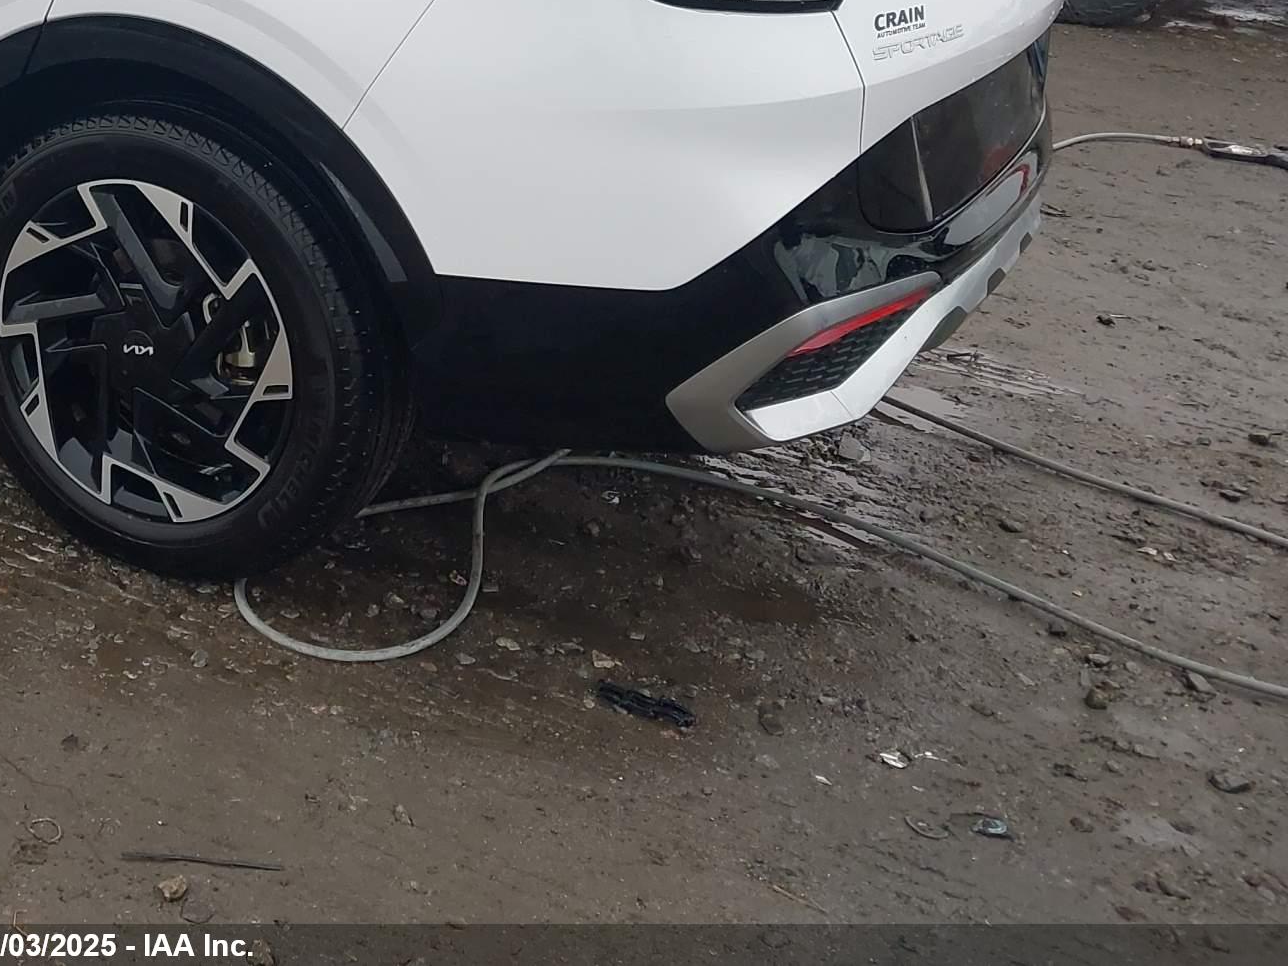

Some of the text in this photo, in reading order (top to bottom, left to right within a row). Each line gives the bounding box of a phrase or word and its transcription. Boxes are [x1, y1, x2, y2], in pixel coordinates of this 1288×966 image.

[874, 5, 925, 31] CRAIN
[877, 22, 926, 39] AUTOMOTIVE TEAM
[872, 23, 964, 61] SPORTAGE
[123, 344, 154, 356] KIA
